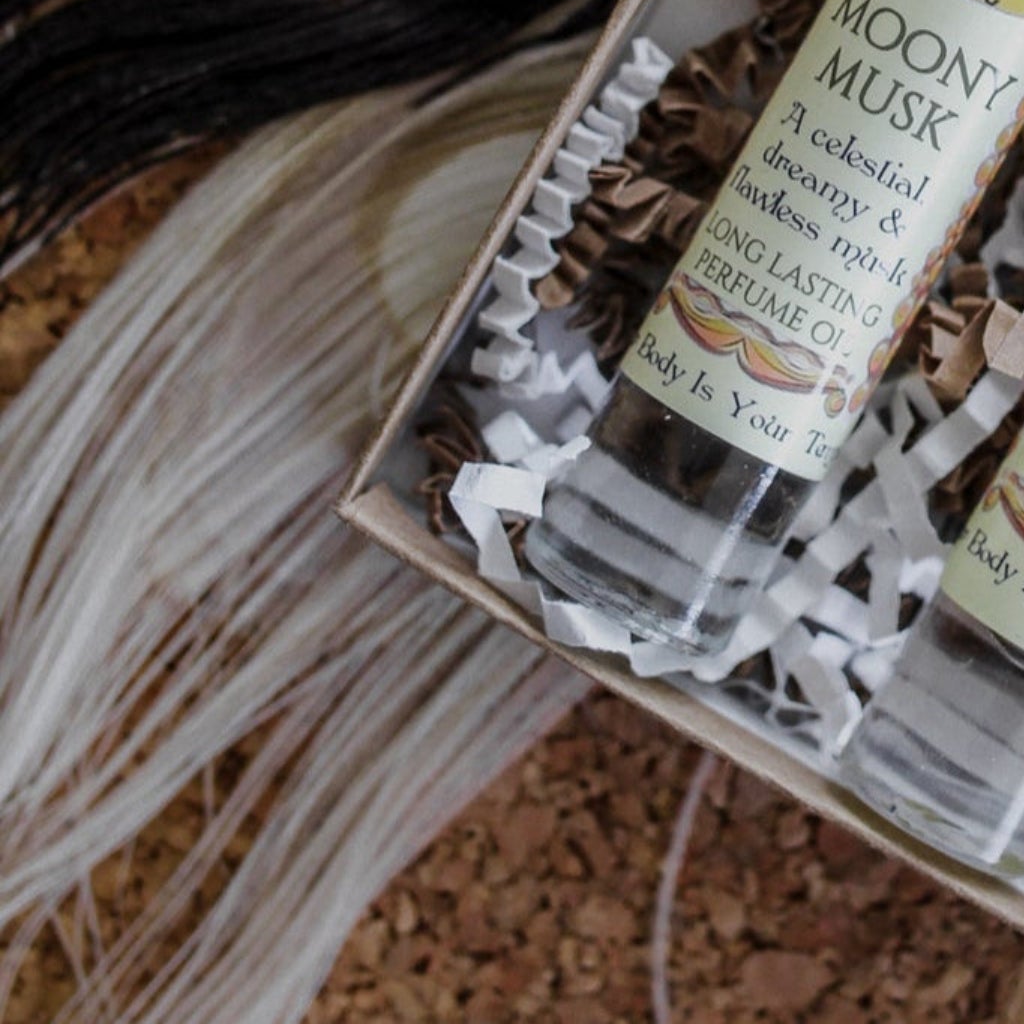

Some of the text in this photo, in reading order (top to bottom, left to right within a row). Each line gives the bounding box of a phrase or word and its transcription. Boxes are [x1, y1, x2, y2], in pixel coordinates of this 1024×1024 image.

[815, 45, 959, 152] MUSK
[729, 164, 821, 242] flawless
[762, 141, 907, 239] dreamy &
[780, 101, 933, 204] A celestial
[693, 247, 853, 357] PERFUME OI
[706, 209, 883, 328] LONG LASTING
[636, 333, 687, 386] Body
[690, 370, 716, 402] Is
[729, 391, 792, 443] Your
[967, 527, 1018, 586] Body
